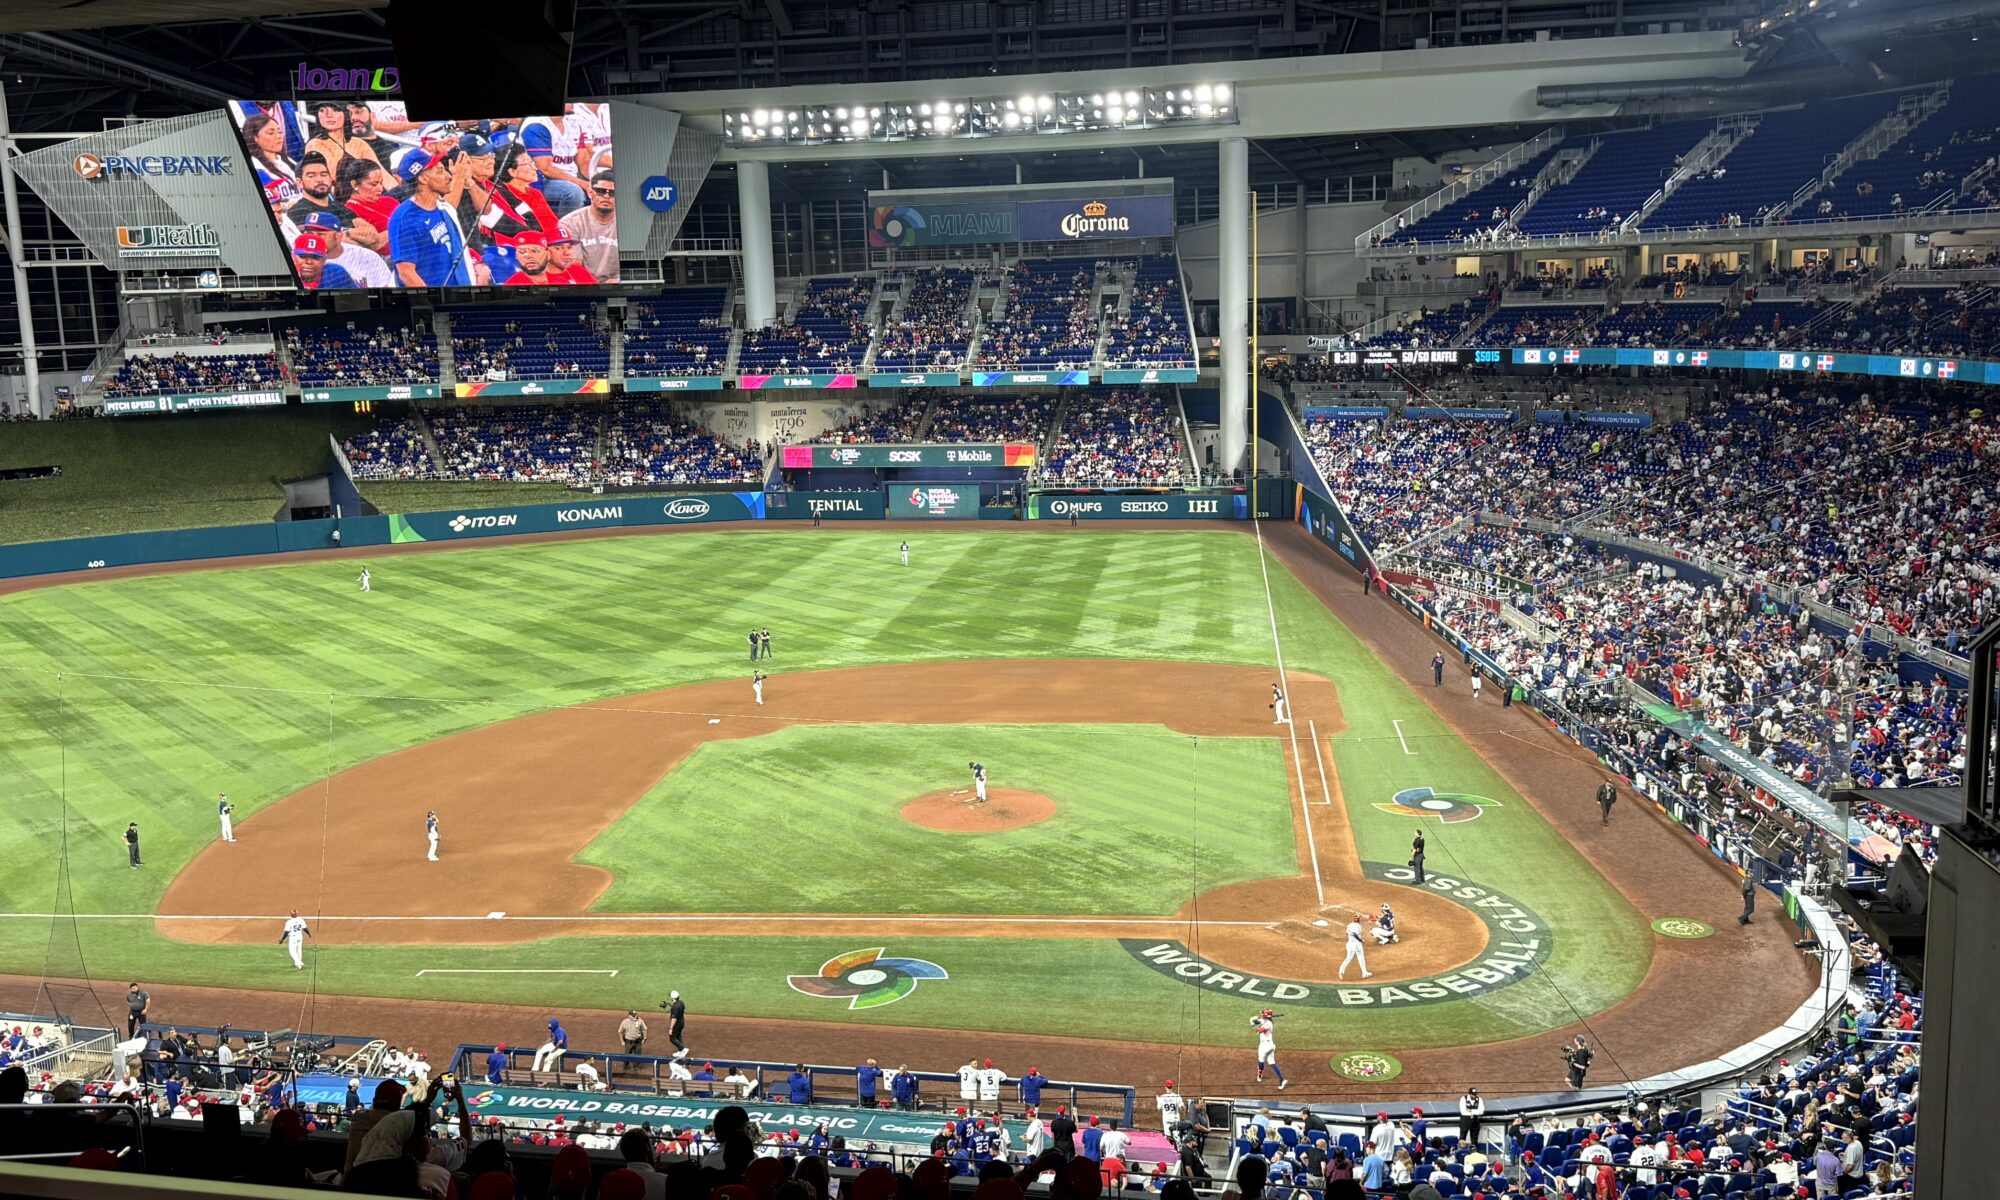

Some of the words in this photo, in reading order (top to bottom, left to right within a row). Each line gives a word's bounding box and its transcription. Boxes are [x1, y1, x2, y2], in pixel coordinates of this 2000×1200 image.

[105, 156, 232, 175] PNCBANK
[646, 187, 673, 201] ADT
[931, 212, 1012, 237] MIAMI
[1060, 213, 1130, 239] Corona
[153, 223, 218, 247] Health
[201, 274, 218, 286] 42
[1402, 350, 1430, 364] 50/50
[1431, 351, 1457, 362] RAFFLE
[188, 398, 211, 406] PITCH
[212, 396, 232, 405] TYPE
[231, 392, 281, 404] CURVEBALL
[107, 402, 130, 411] PITCH
[131, 401, 156, 409] SPEED
[727, 417, 747, 432] 1796
[775, 416, 805, 435] 1796
[889, 450, 922, 462] SCSK
[958, 450, 992, 462] Mobile
[592, 486, 604, 494] 387
[667, 503, 709, 515] Kowa
[808, 499, 864, 511] TENTIAL
[1070, 502, 1102, 512] MUFG
[1120, 501, 1169, 512] SEIKO
[1188, 500, 1218, 513] IHI
[470, 515, 495, 528] ITO
[495, 514, 518, 527] EN
[557, 506, 623, 523] KONAMI
[87, 560, 105, 568] 400
[1140, 942, 1311, 1000] WORLD
[1337, 936, 1540, 1005] BASEBALL
[508, 1095, 602, 1112] WORLD
[603, 1102, 719, 1120] BASEBAL
[746, 1111, 858, 1129] CLASSIC
[1163, 1103, 1176, 1112] 99
[1641, 1155, 1655, 1167] 22
